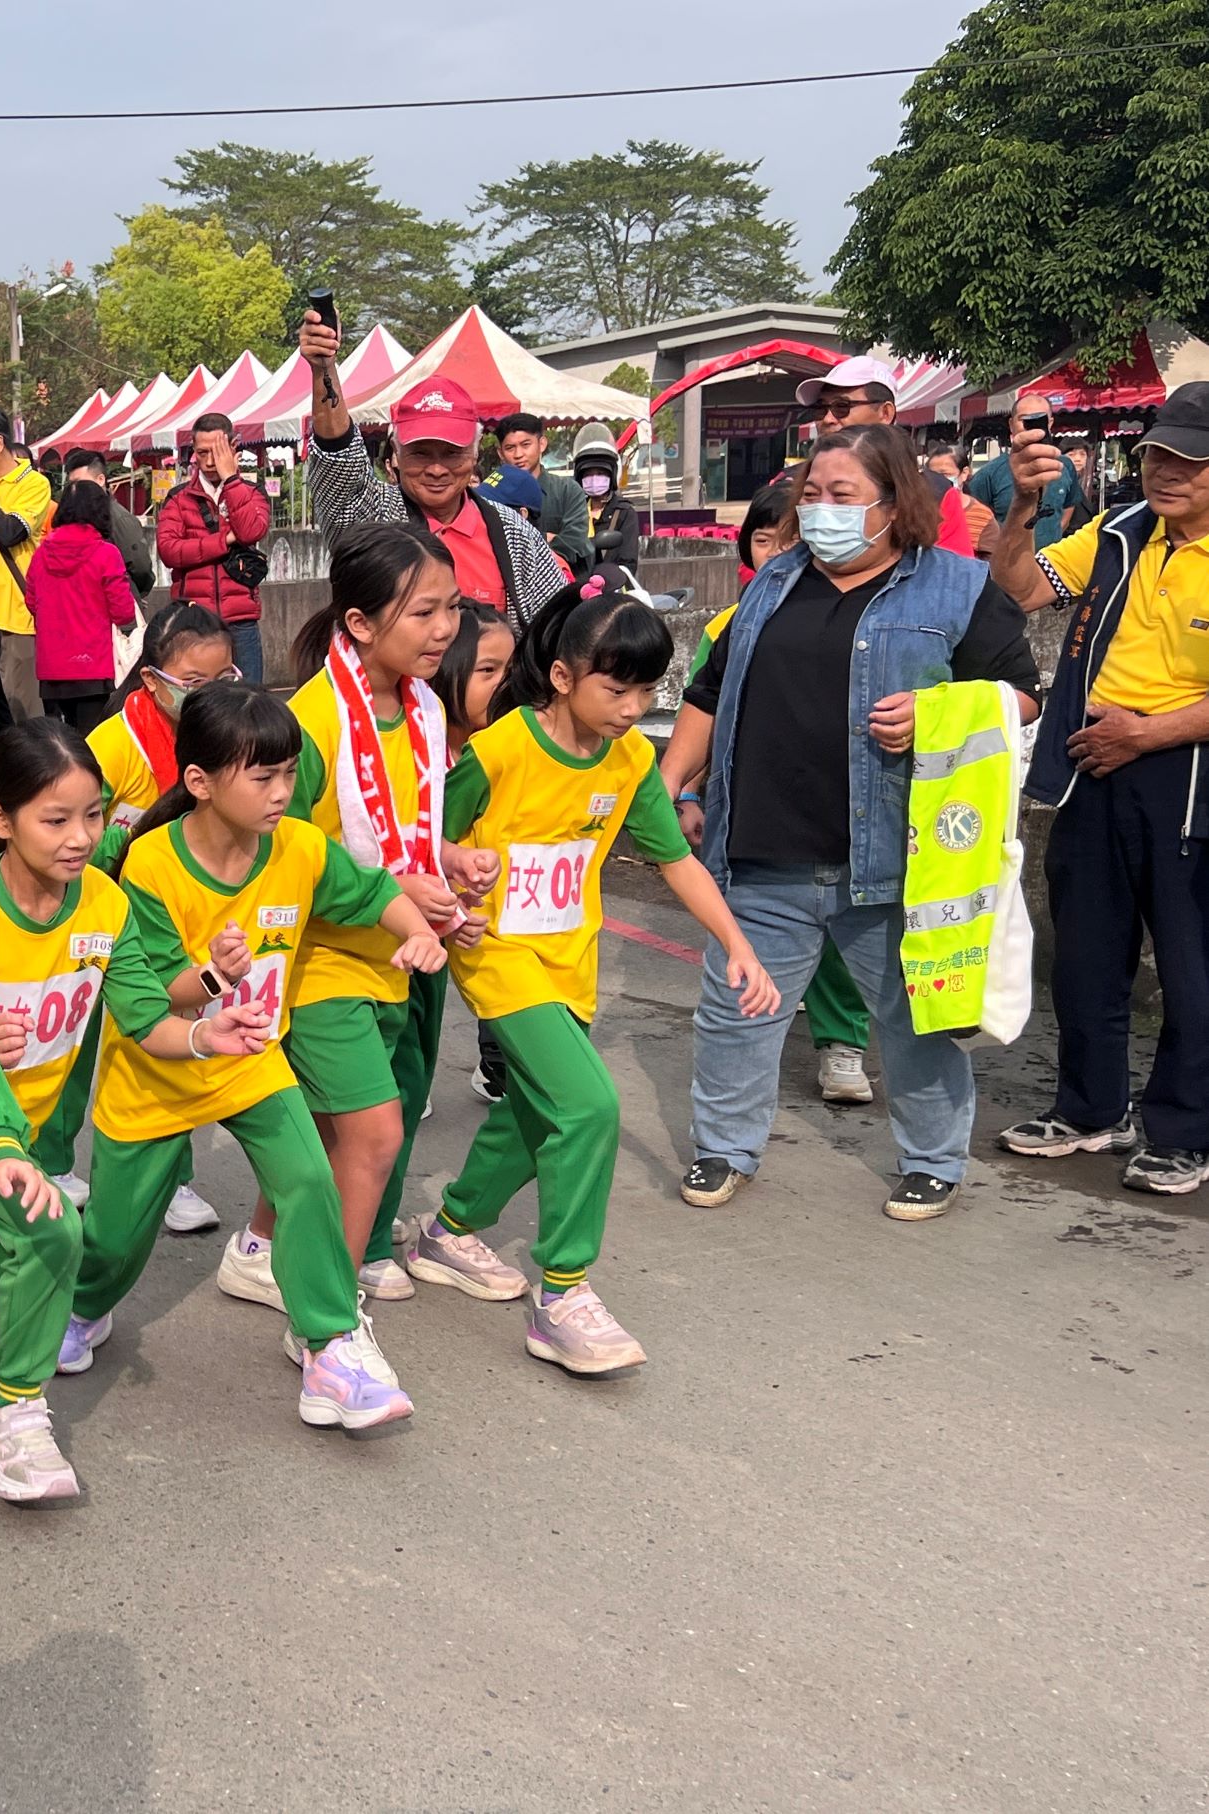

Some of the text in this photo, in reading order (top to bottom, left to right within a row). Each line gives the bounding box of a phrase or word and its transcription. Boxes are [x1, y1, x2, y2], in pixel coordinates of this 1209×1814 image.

[947, 811, 971, 842] K
[551, 854, 584, 909] 03
[36, 981, 93, 1044] 08
